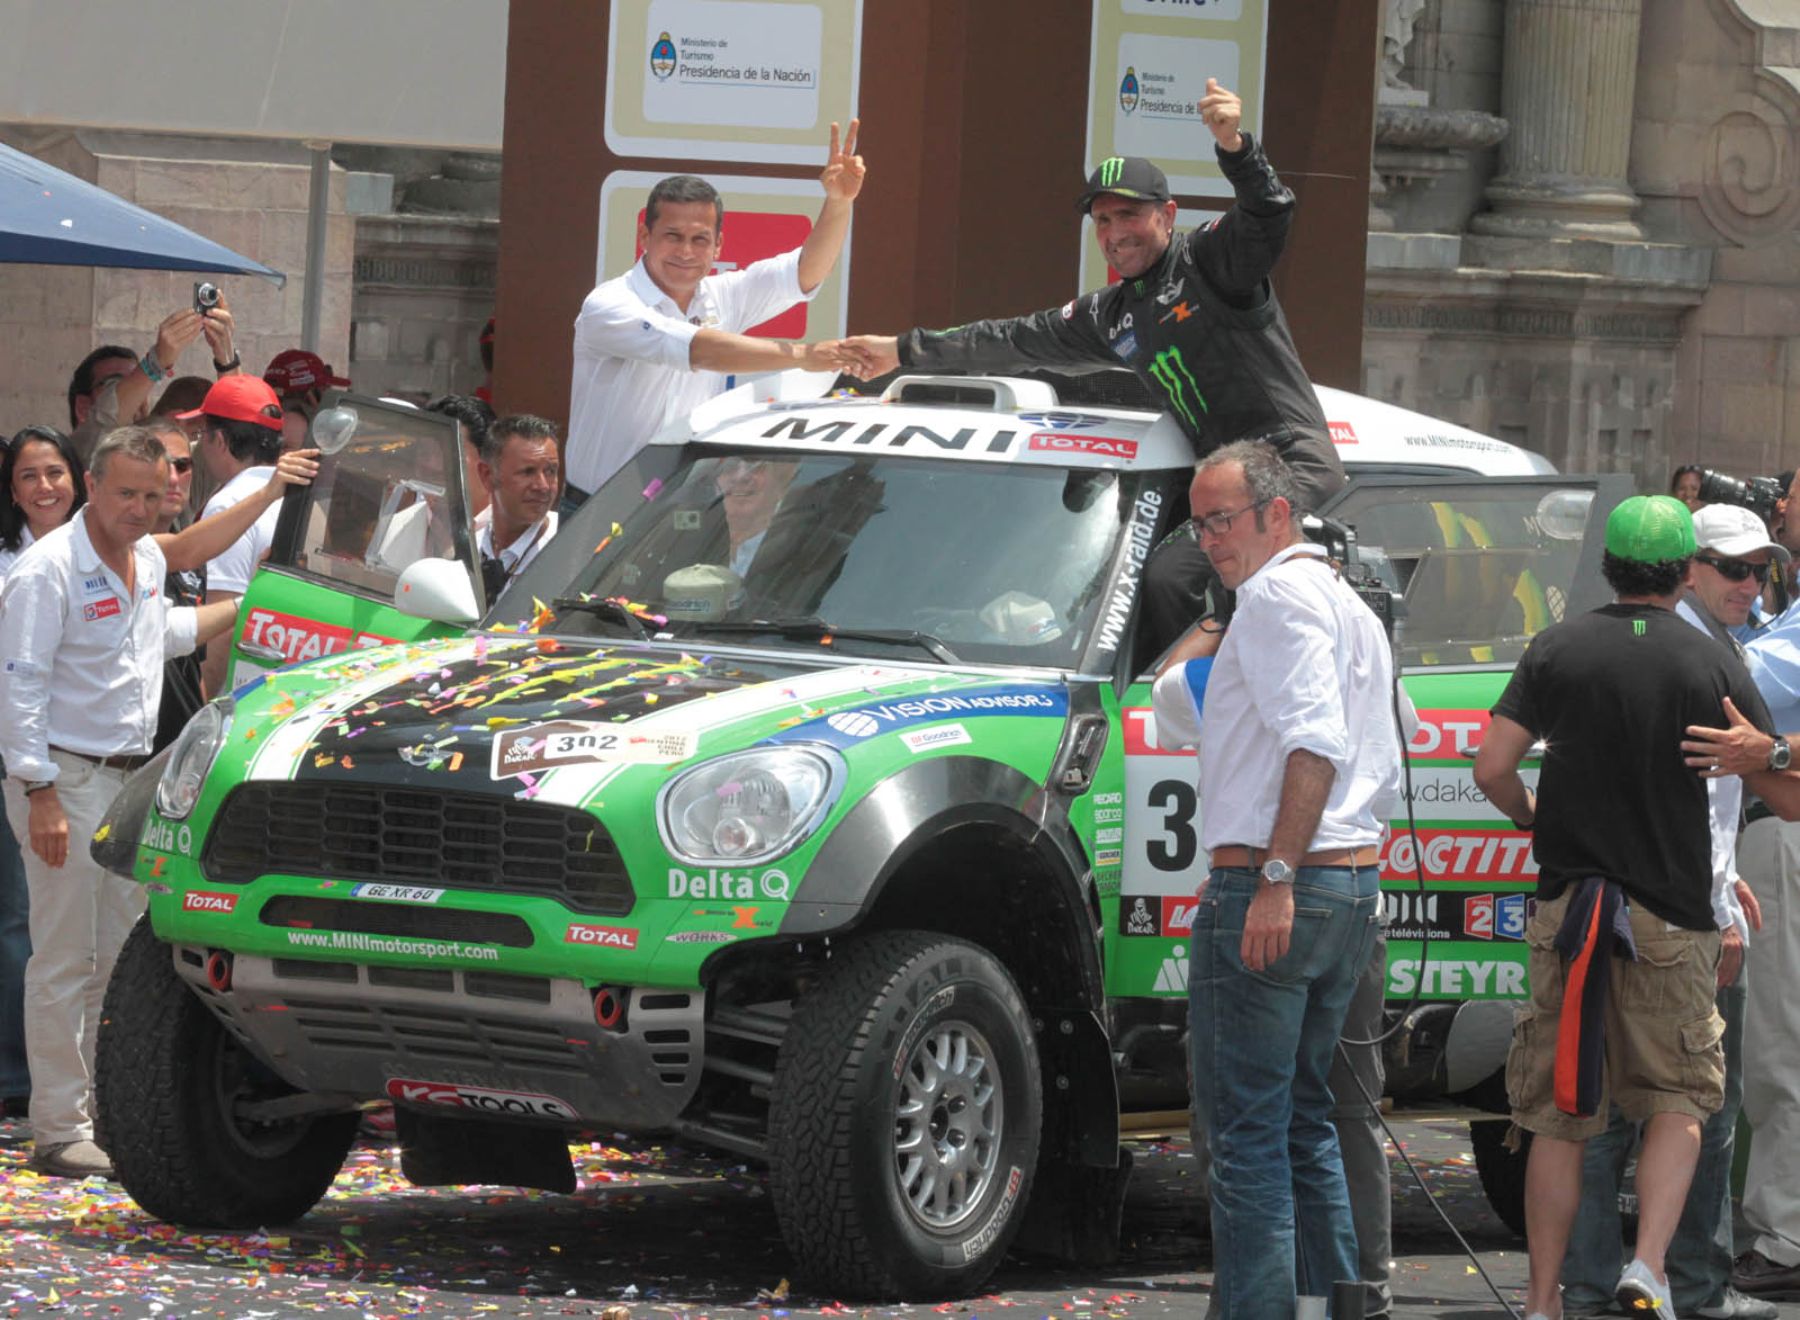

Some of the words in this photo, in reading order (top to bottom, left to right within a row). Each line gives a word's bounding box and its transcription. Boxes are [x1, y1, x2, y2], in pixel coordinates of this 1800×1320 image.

[681, 38, 717, 48] Ministerio
[718, 39, 728, 48] de
[681, 50, 714, 60] Turismo
[680, 64, 740, 79] Presidencia
[744, 67, 757, 80] de
[761, 67, 770, 80] la
[774, 68, 811, 82] Nación
[1141, 99, 1183, 114] Presidencia
[1185, 102, 1195, 114] de
[761, 417, 1018, 453] MINI
[1330, 427, 1357, 442] TAL
[1036, 436, 1136, 456] TOTAL
[1097, 487, 1162, 652] www.x-raid.de
[862, 696, 970, 721] VISION
[668, 868, 754, 899] Delta
[186, 893, 233, 911] TOTAL
[413, 889, 434, 900] 60
[1471, 905, 1493, 931] 2
[1503, 906, 1524, 932] 3
[287, 931, 499, 961] www.MINImotorsport.com
[569, 926, 635, 947] TOTAL
[1388, 958, 1527, 995] STEYR
